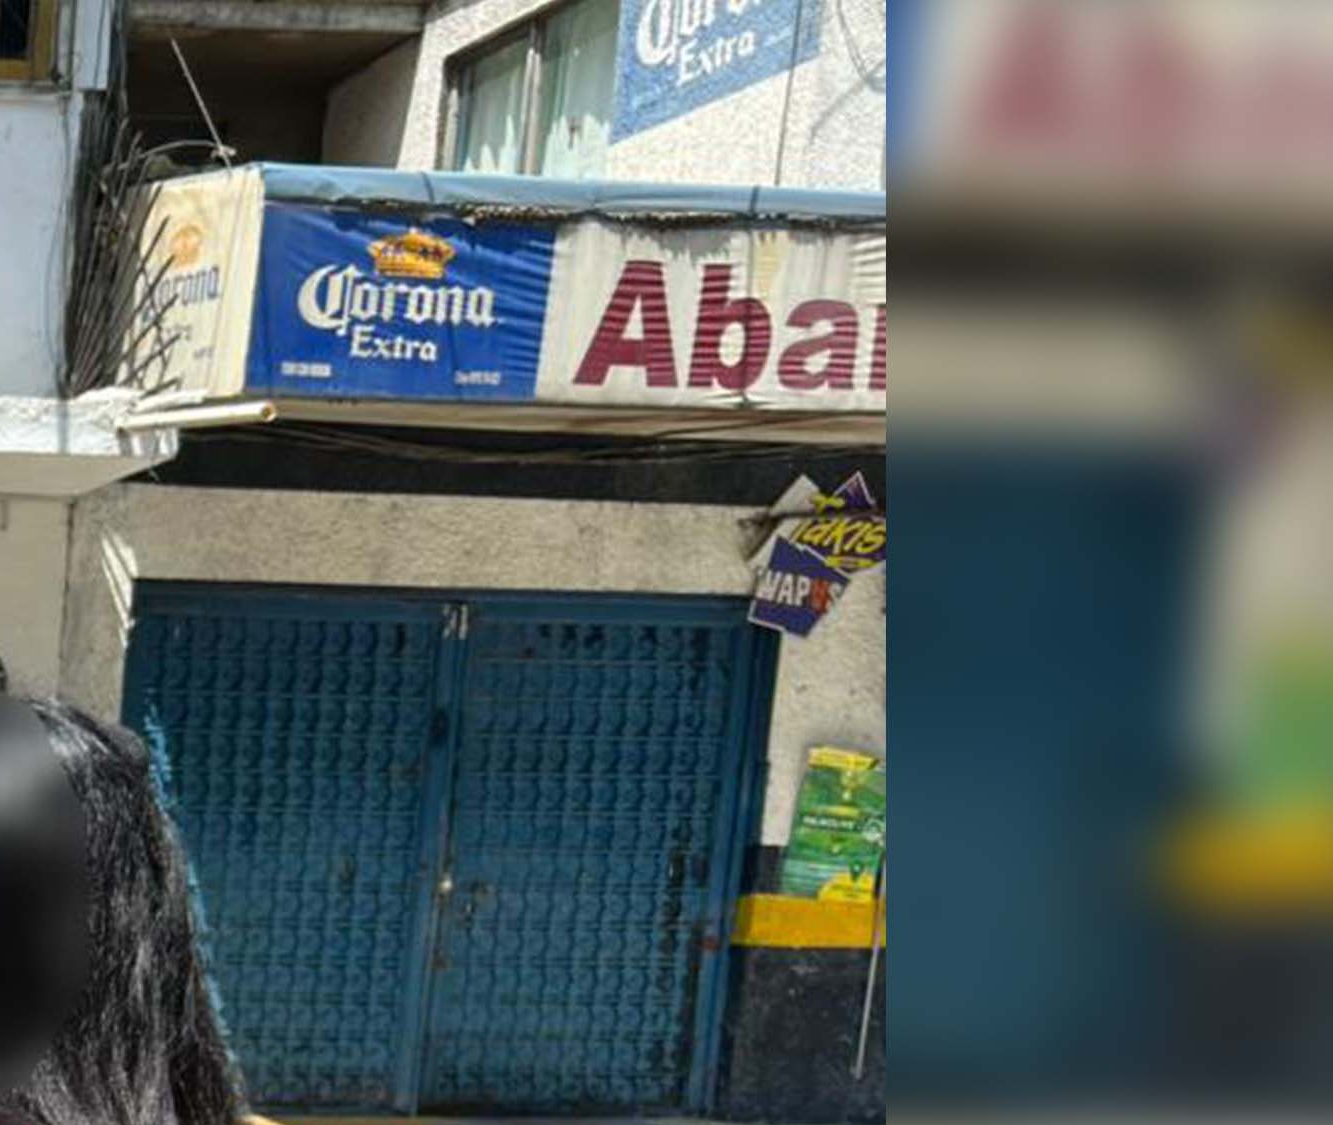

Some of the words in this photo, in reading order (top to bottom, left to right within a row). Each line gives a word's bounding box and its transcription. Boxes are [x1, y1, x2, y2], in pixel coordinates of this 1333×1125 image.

[677, 32, 756, 87] Extra
[297, 263, 499, 336] Corona
[349, 324, 438, 362] Extra
